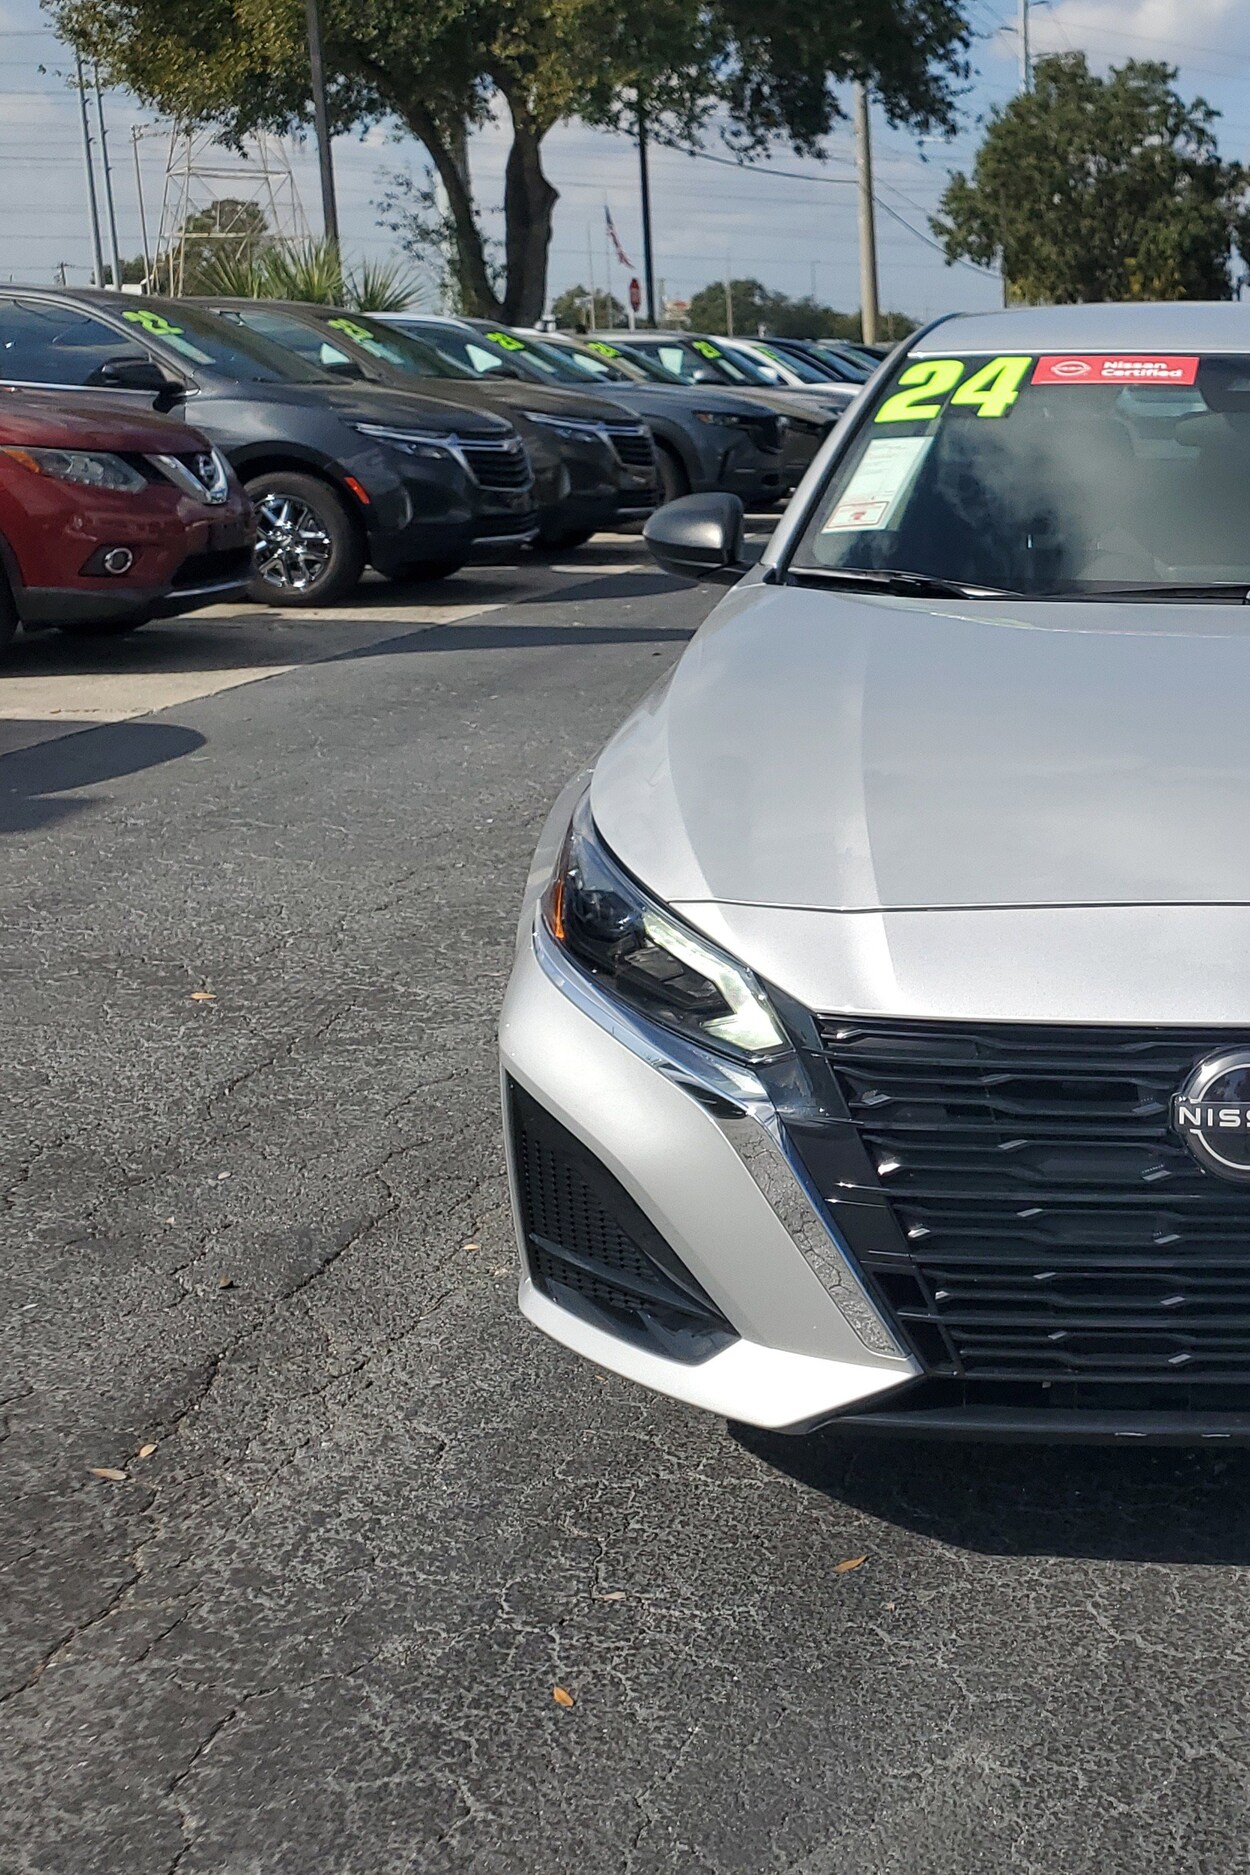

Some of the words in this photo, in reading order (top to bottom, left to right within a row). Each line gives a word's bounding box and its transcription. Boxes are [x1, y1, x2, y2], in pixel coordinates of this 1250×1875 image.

[1103, 360, 1168, 370] Nissan
[1101, 368, 1184, 378] Certified
[874, 356, 1033, 423] 24
